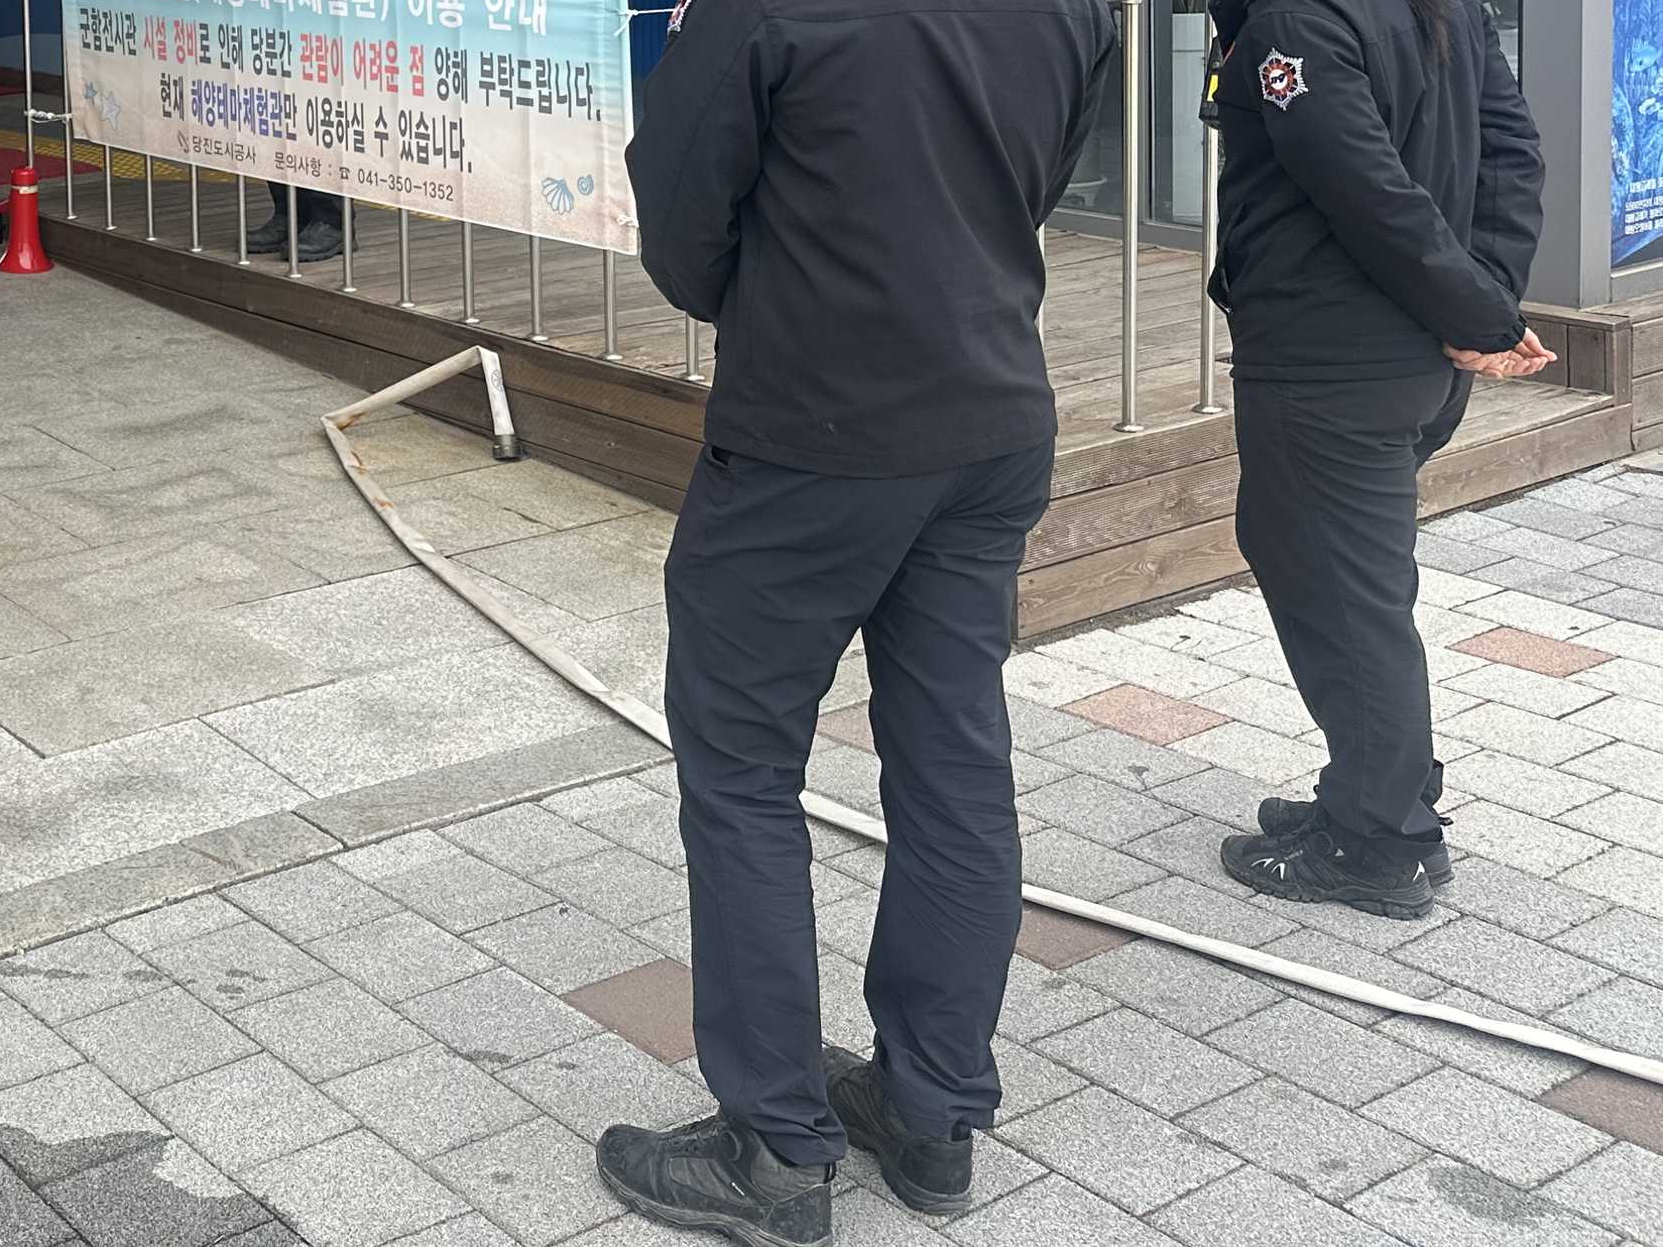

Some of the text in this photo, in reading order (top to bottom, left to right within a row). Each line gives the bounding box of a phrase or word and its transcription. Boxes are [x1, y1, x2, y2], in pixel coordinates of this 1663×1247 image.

[79, 7, 602, 122] 군함전시관 시설 정비로 인해 당분간 관람이 어려운 점 양해 부탁드립니다.
[159, 72, 473, 174] 현재 해양테마체험관만 이용하실 수 있습니다.
[192, 134, 257, 164] 당진도시공사
[273, 151, 322, 178] 문의사항
[357, 168, 455, 203] 041-350-1352
